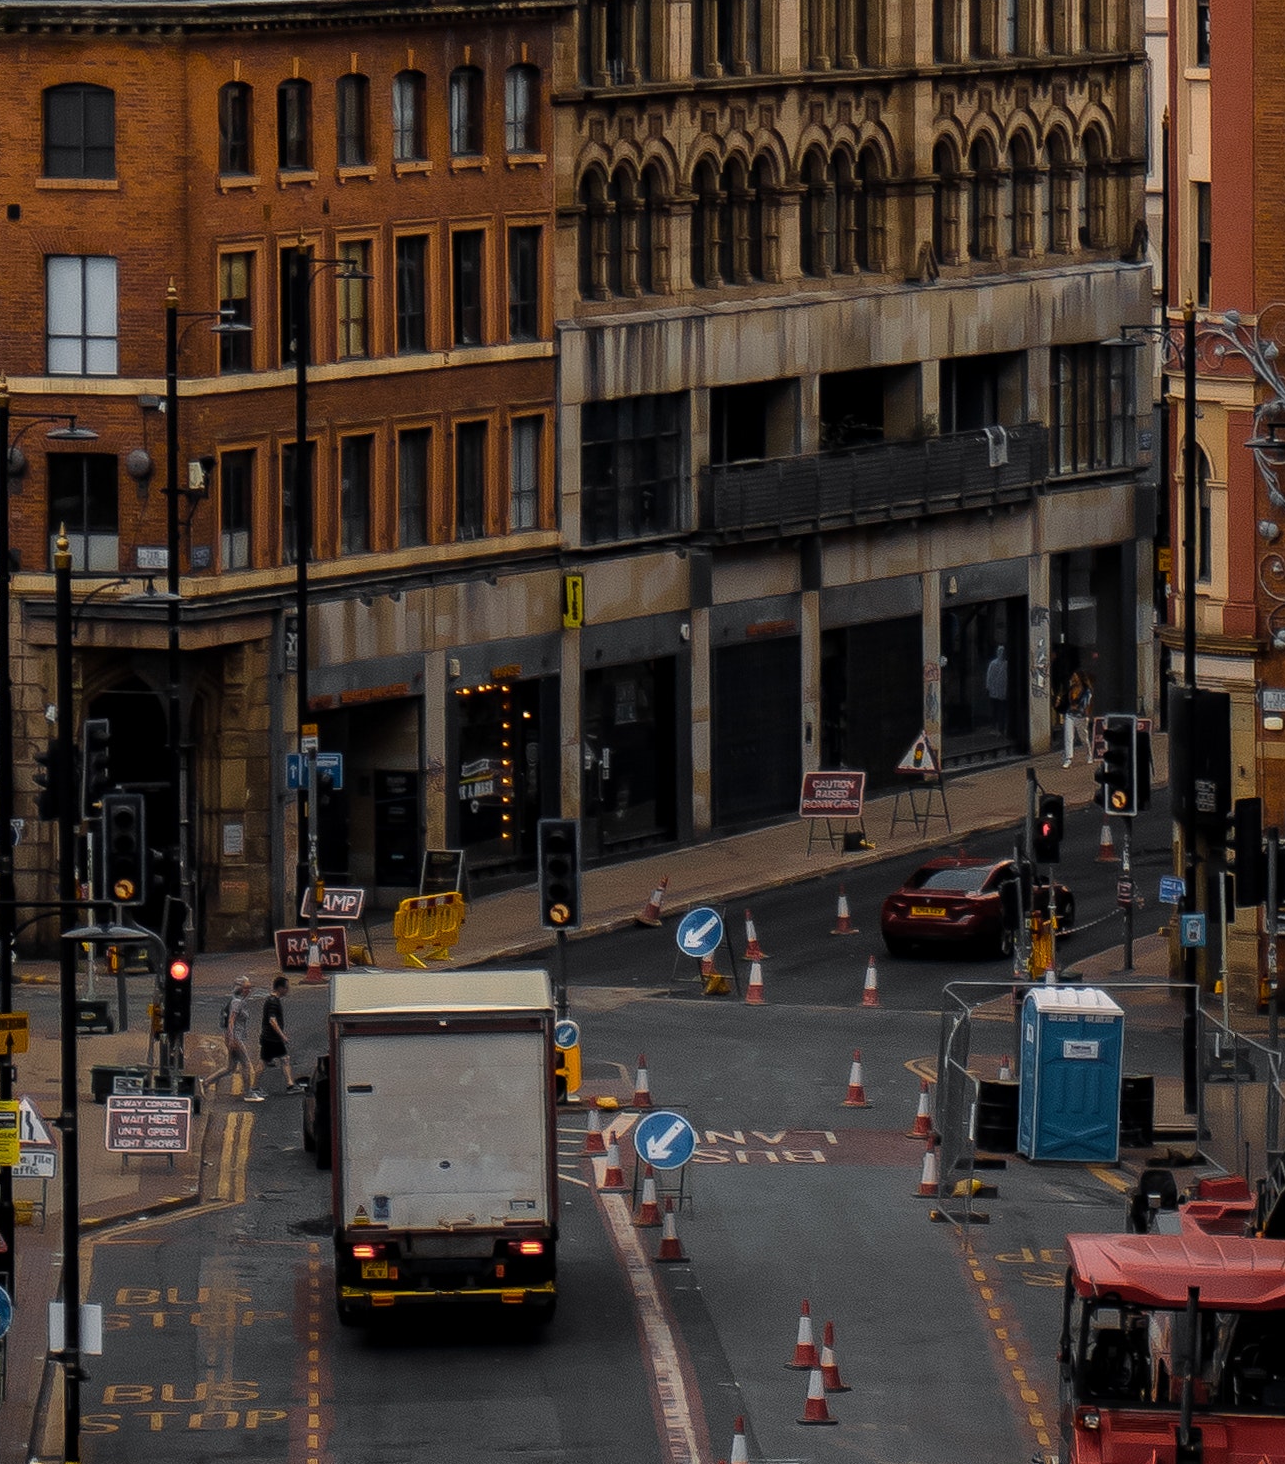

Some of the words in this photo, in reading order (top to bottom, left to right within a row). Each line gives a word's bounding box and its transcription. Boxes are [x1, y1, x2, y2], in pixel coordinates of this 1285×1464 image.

[811, 779, 855, 789] CAUTION
[815, 789, 849, 799] RAISED
[322, 893, 357, 912] AMP
[286, 952, 342, 967] AHAD
[144, 1100, 182, 1109] CONTROL
[120, 1115, 146, 1125] WAIT
[147, 1114, 177, 1125] HERE
[117, 1127, 145, 1137] UNTIL
[147, 1127, 179, 1137] GREEN
[113, 1138, 141, 1148] LIGHT
[144, 1138, 182, 1148] SHOWS
[115, 1287, 252, 1306] BUS
[102, 1380, 260, 1405] BUS
[80, 1409, 289, 1434] STOP
